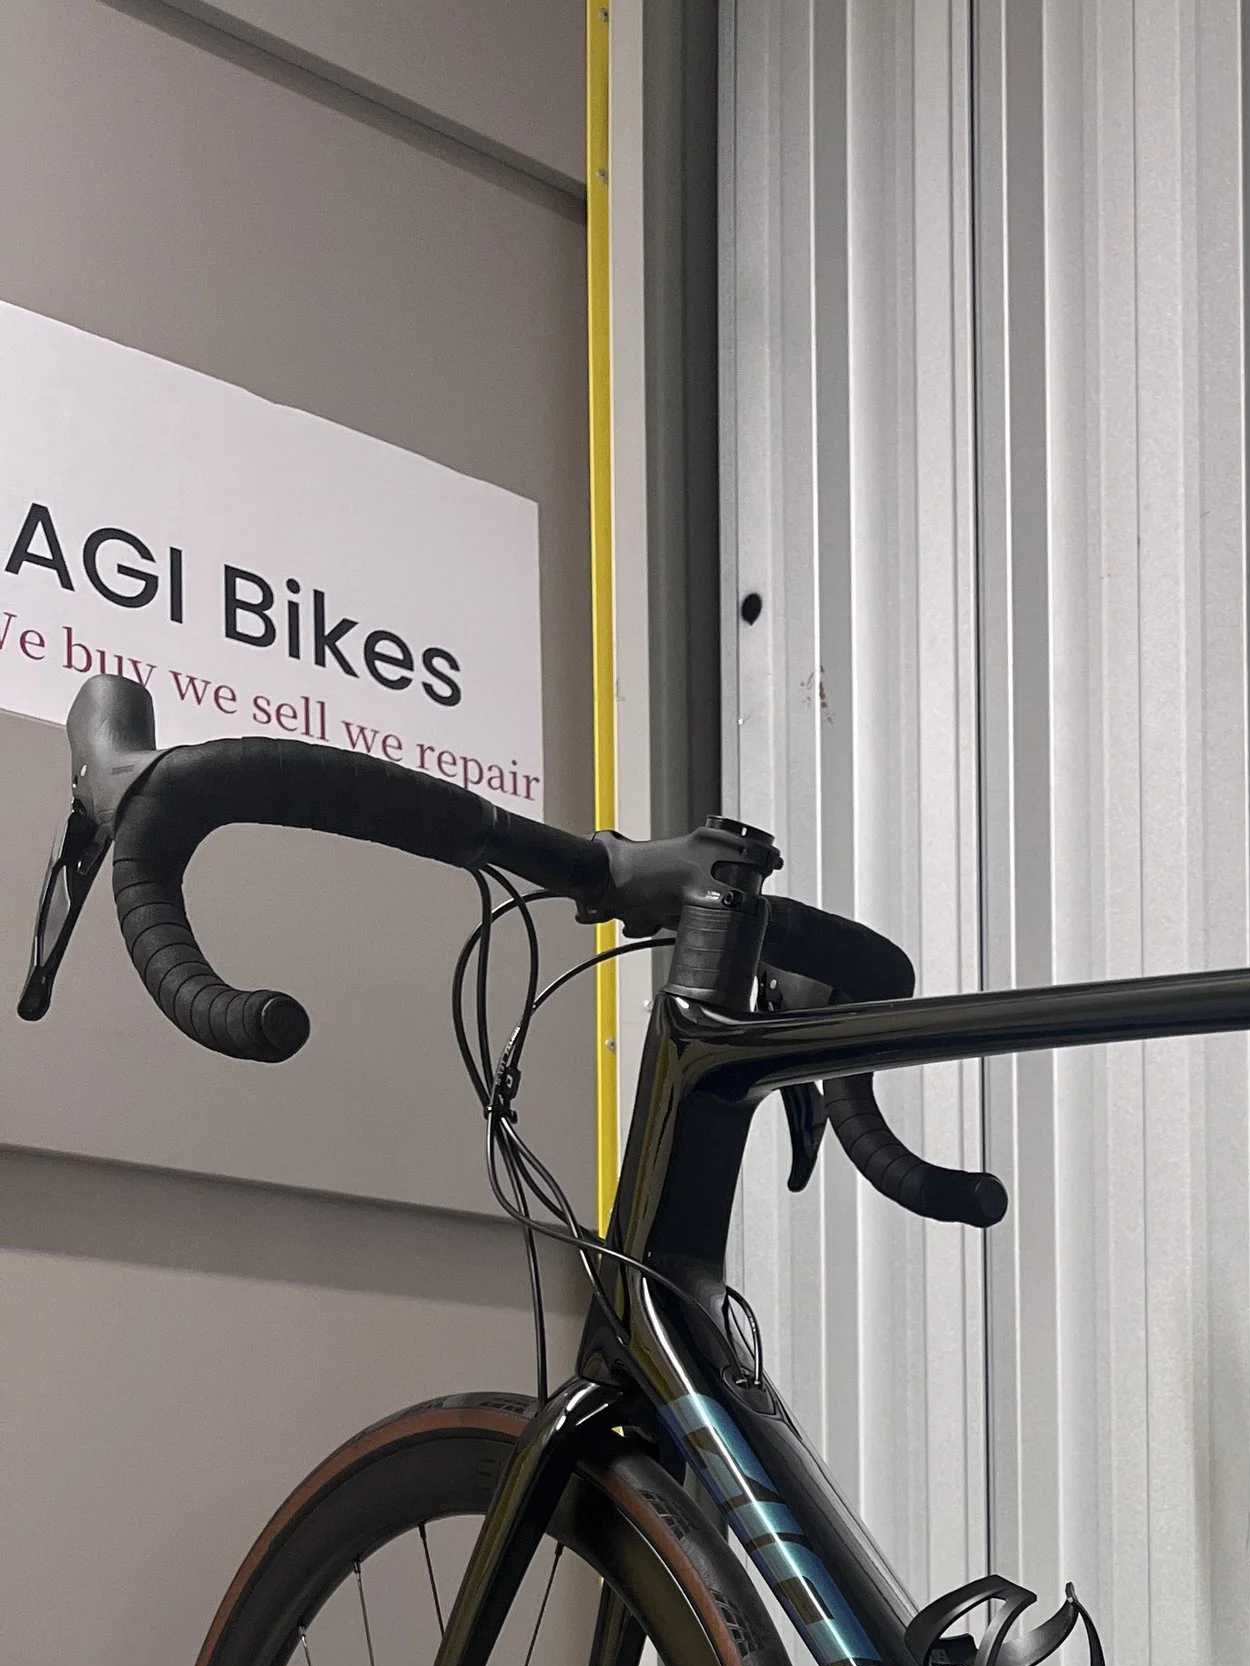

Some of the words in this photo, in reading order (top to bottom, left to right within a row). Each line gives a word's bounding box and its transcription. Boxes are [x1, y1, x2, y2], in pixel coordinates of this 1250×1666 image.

[4, 503, 183, 624] AGI
[223, 563, 462, 707] Bikes
[169, 670, 238, 714] we
[252, 696, 328, 742] sell
[342, 720, 403, 763] we
[416, 743, 540, 801] repair
